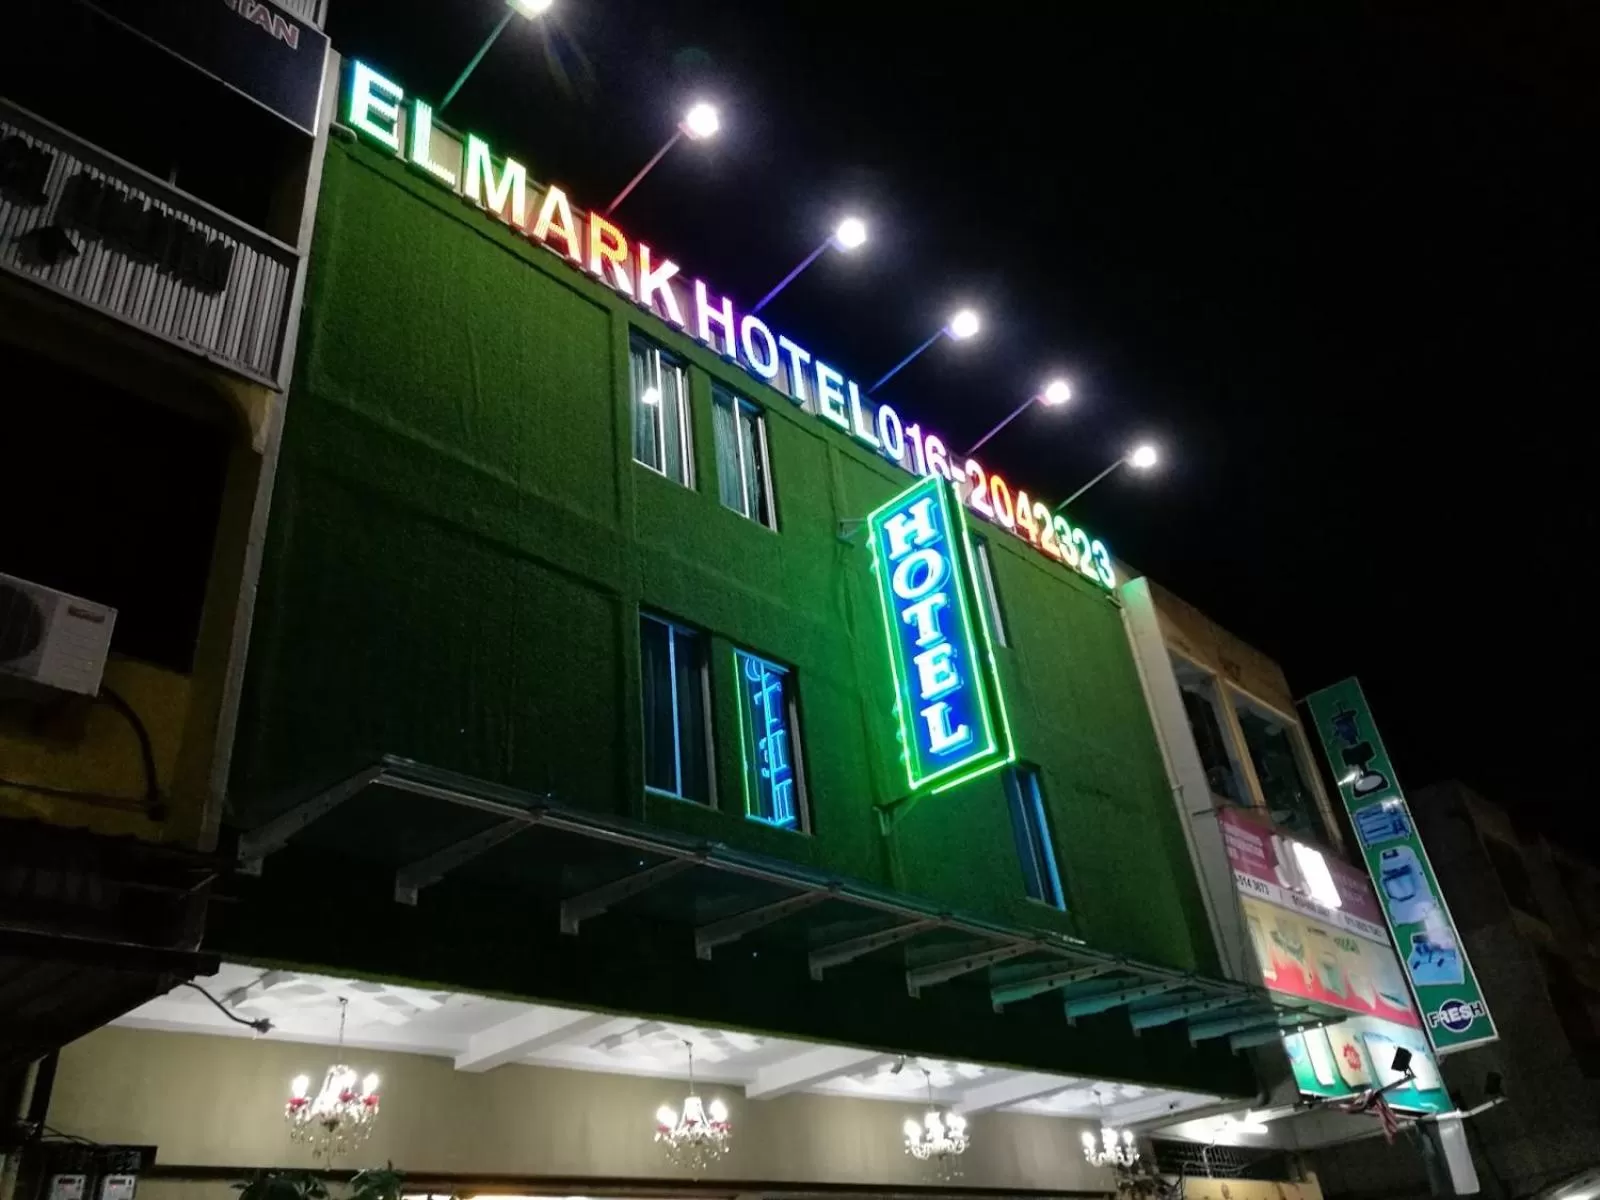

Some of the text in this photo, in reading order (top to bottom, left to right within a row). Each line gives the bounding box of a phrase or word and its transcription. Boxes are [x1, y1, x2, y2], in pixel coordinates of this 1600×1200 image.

[350, 60, 1116, 590] ELMARK HOTEL 016-2042323
[884, 497, 972, 756] HOTEL
[1427, 999, 1485, 1029] FRESH
